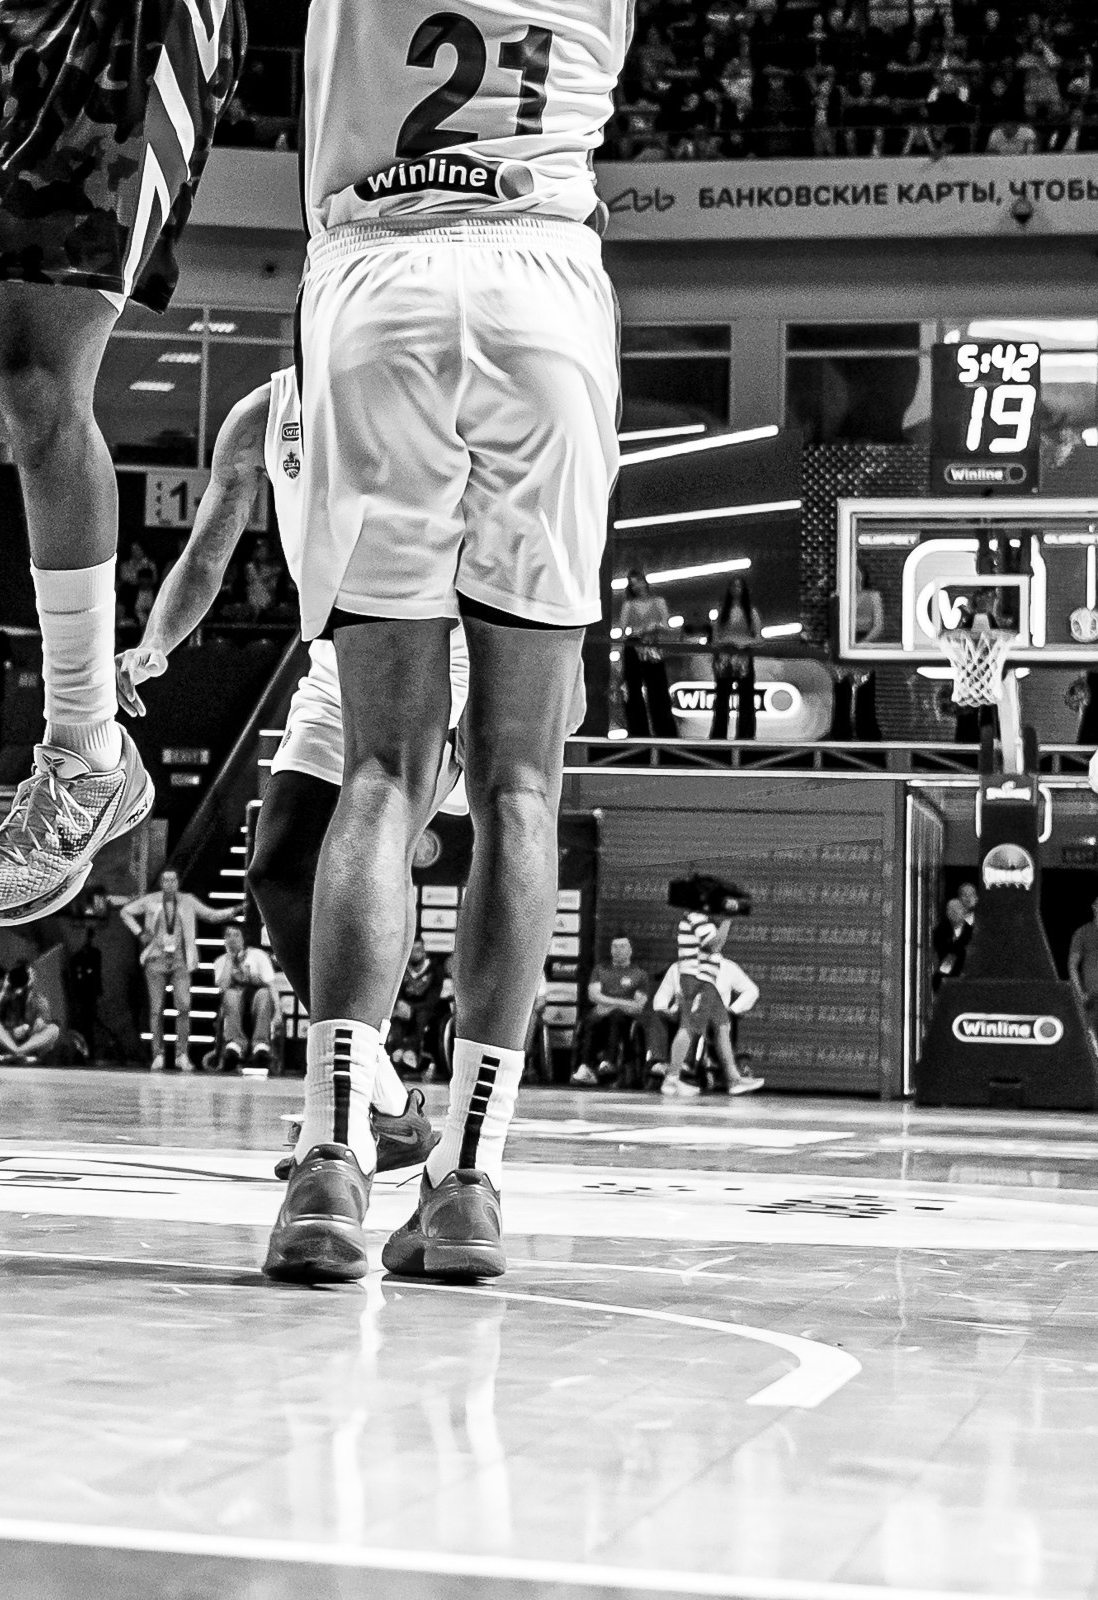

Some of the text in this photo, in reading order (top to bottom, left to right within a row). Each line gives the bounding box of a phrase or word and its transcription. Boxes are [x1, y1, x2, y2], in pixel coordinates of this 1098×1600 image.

[395, 11, 554, 159] 21
[698, 181, 889, 210] БАНКОВСКИЕ
[896, 180, 1002, 206] КАРТЫ,
[957, 343, 1040, 383] 5:42
[965, 384, 1037, 454] 19
[950, 467, 1003, 481] Winline
[962, 1019, 1032, 1039] Winline
